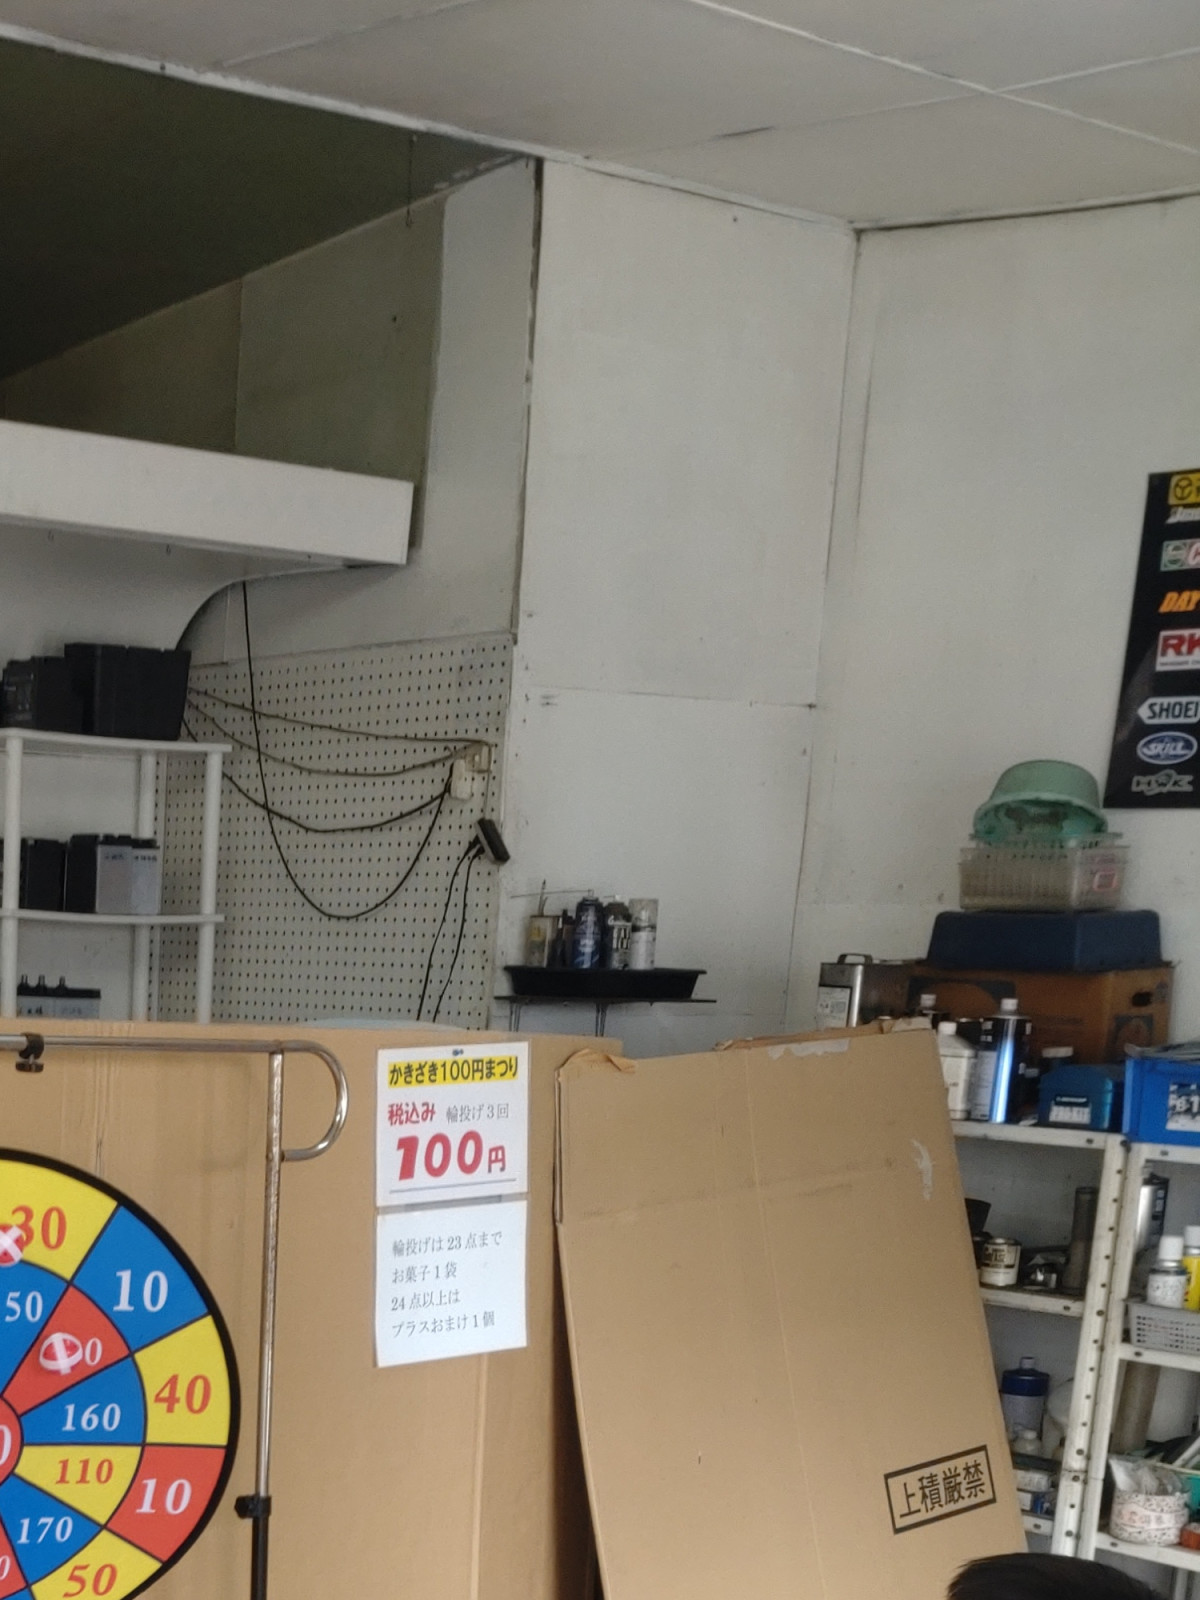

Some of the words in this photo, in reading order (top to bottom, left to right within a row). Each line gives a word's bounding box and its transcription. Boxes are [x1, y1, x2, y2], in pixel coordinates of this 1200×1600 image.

[1147, 702, 1199, 719] SHOEI
[389, 1058, 518, 1086] かきざき100円まつり
[388, 1101, 436, 1125] 税込み
[396, 1129, 506, 1181] 100円
[10, 1206, 66, 1250] 30
[392, 1265, 458, 1285] お菓子1袋
[113, 1270, 168, 1312] 10
[391, 1288, 461, 1312] 24点以上は
[154, 1375, 211, 1414] 40
[62, 1404, 121, 1432] 160
[56, 1459, 113, 1485] 110
[136, 1479, 191, 1515] 10
[899, 1461, 985, 1518] 上積厳禁
[18, 1516, 72, 1544] 170
[63, 1563, 117, 1598] 50
